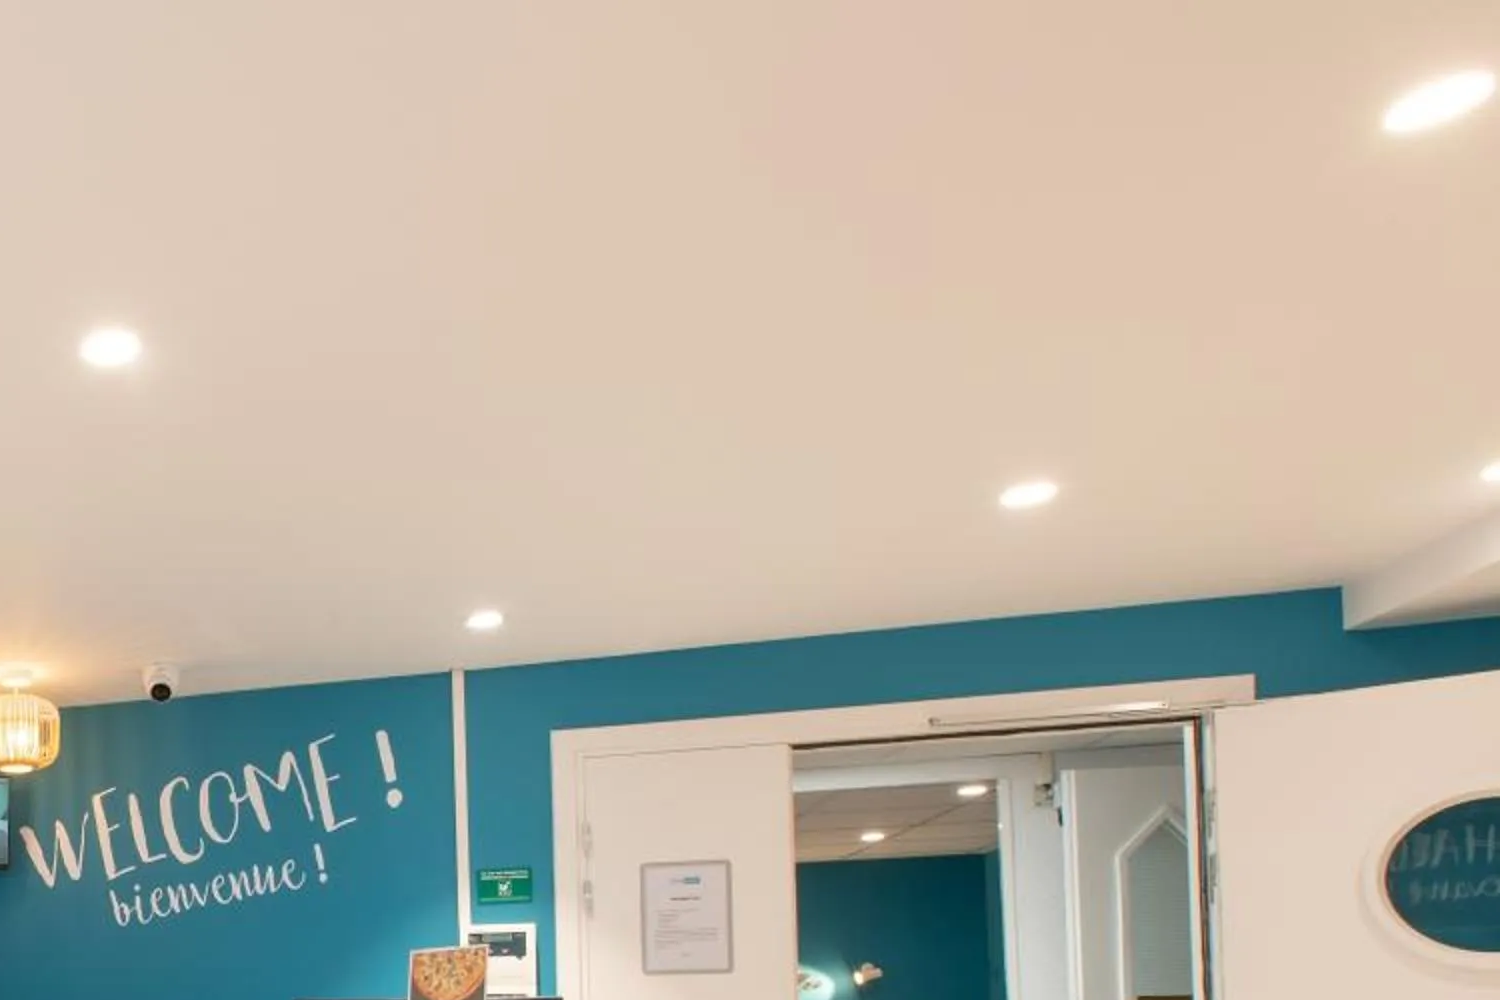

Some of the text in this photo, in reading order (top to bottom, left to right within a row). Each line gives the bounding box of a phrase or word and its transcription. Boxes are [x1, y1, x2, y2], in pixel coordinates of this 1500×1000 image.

[19, 728, 404, 890] WELCOME !
[108, 842, 329, 928] bienvenue !
